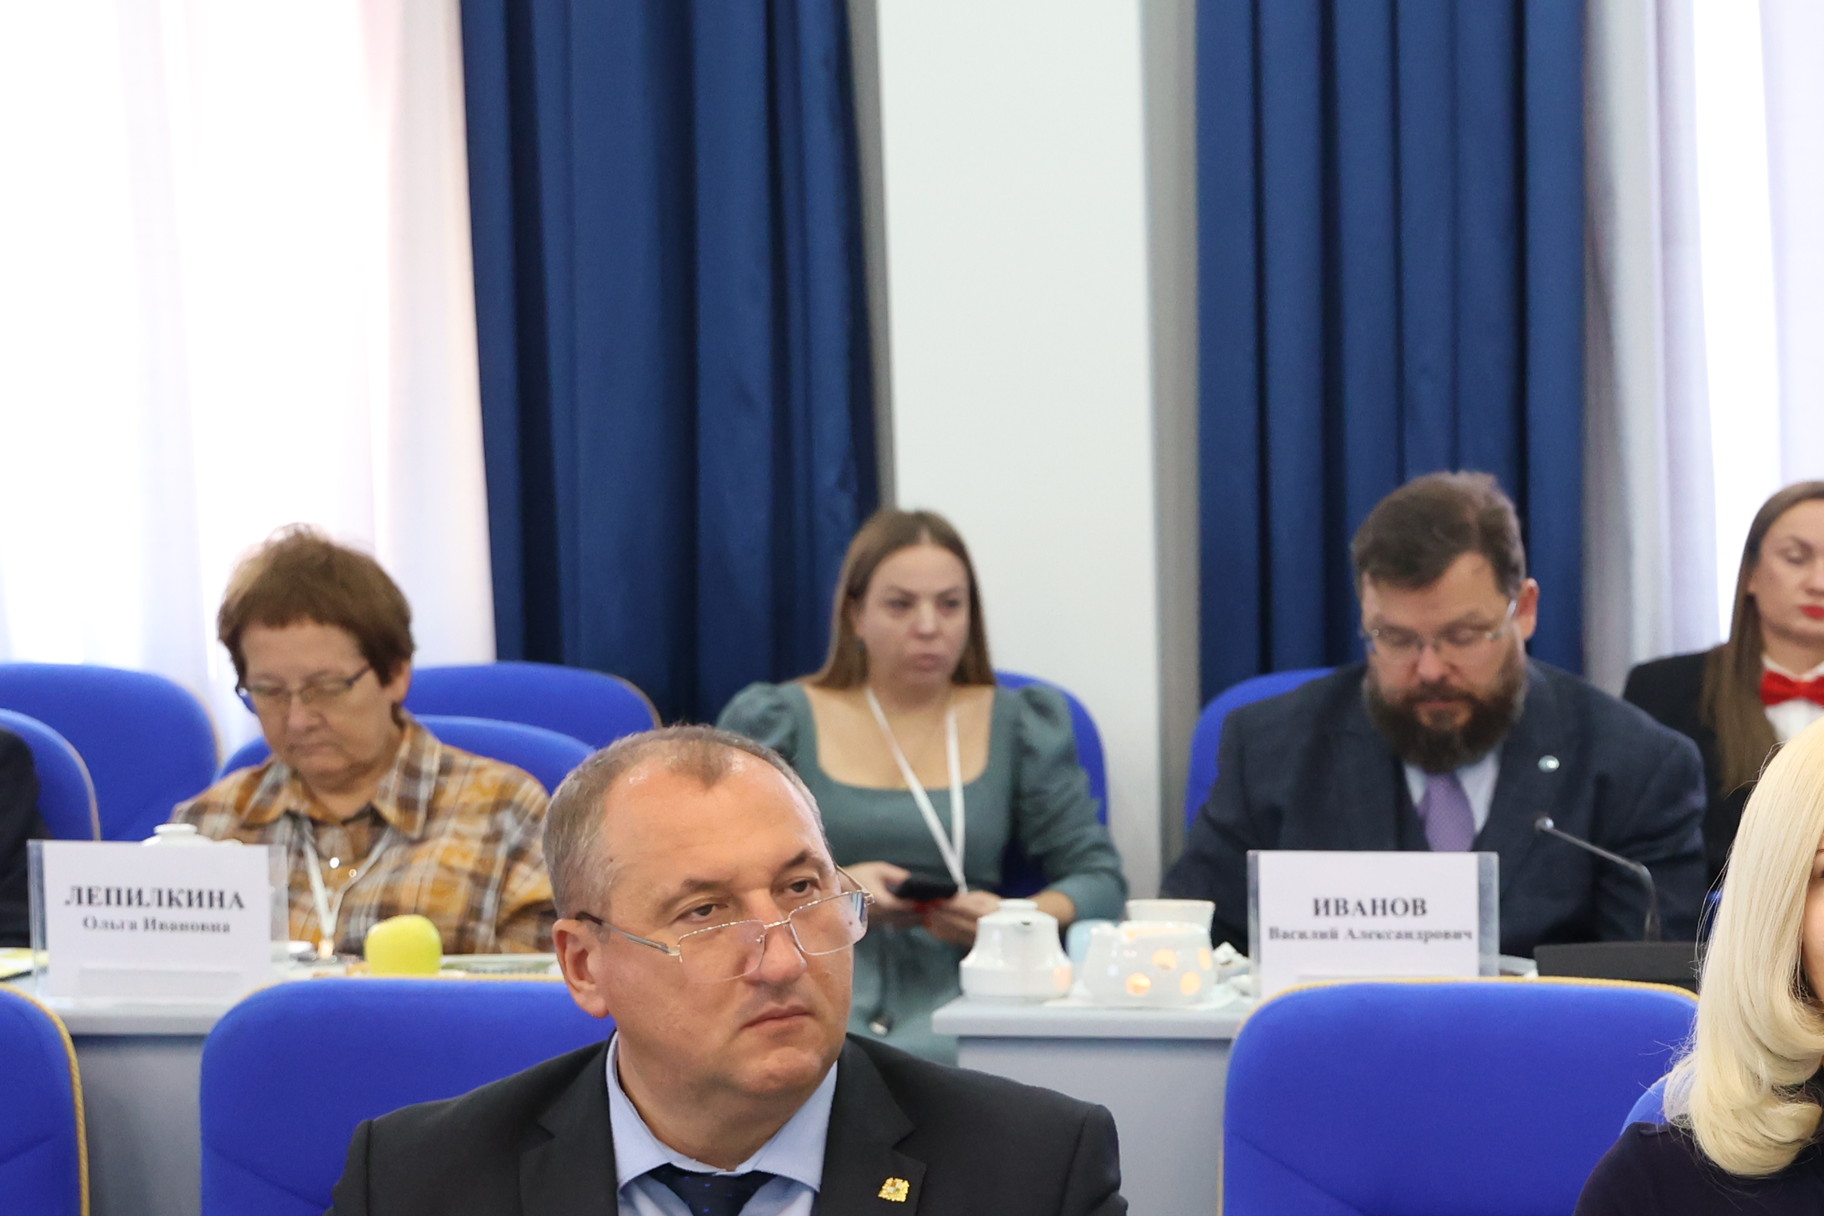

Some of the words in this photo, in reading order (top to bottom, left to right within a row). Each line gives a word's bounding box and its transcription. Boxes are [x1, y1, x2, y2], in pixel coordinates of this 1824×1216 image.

[65, 886, 245, 909] ЛЕПИЛКИНА
[1312, 897, 1427, 917] ИВАНОВ
[83, 915, 138, 934] Ольга
[143, 917, 231, 933] Ивановна
[1268, 925, 1338, 940] Василий
[1345, 927, 1473, 944] Александрович
